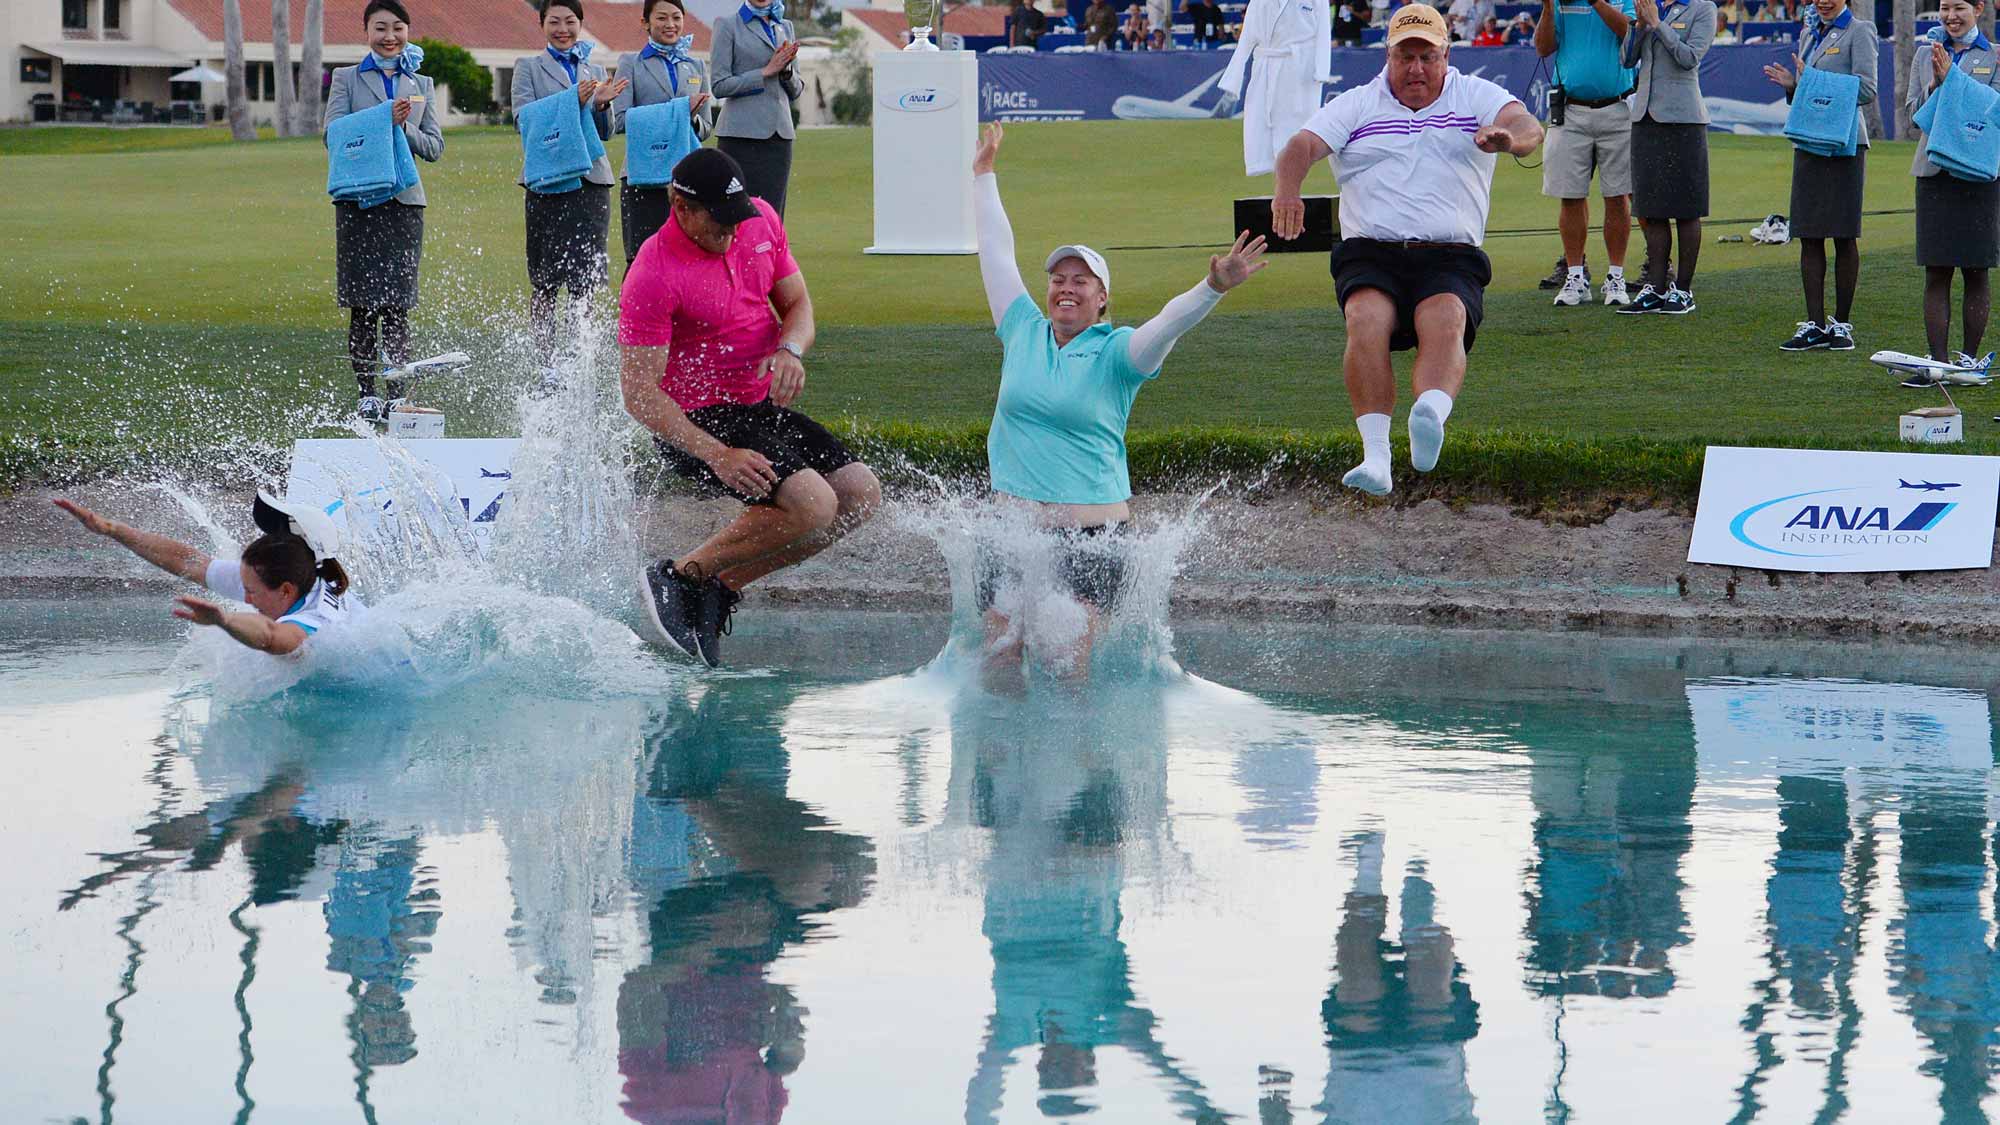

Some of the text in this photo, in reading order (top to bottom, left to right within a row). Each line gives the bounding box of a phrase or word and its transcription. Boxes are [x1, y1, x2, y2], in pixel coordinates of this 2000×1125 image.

[1396, 15, 1432, 29] Titleist
[993, 92, 1027, 108] RACE
[1784, 505, 1889, 531] ANA
[1781, 532, 1928, 545] INSPIRATION
[661, 585, 669, 604] FILA
